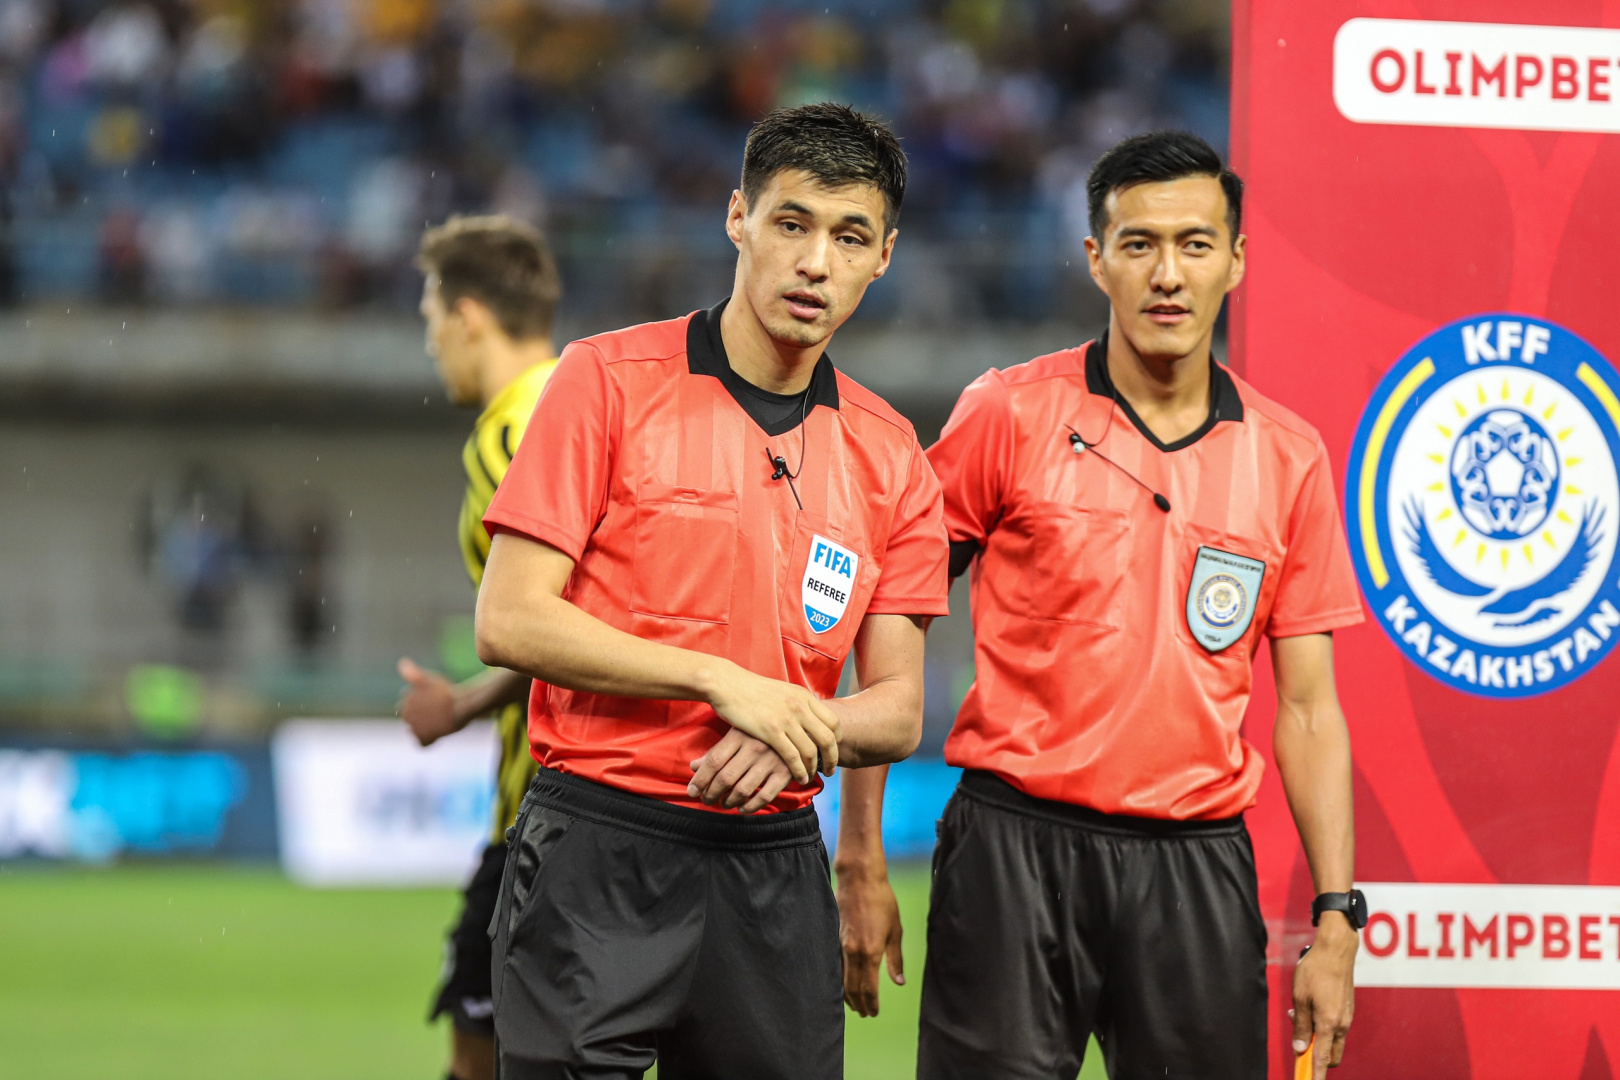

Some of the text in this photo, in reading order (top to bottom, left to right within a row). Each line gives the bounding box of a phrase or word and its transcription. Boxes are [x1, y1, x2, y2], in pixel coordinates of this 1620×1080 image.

[1370, 48, 1620, 102] OLIMPBE
[1461, 321, 1551, 365] KFF
[814, 542, 851, 579] FIFA
[807, 577, 846, 604] REFEREE
[810, 611, 830, 627] 2023
[1384, 595, 1620, 688] KAZAKHSTAN
